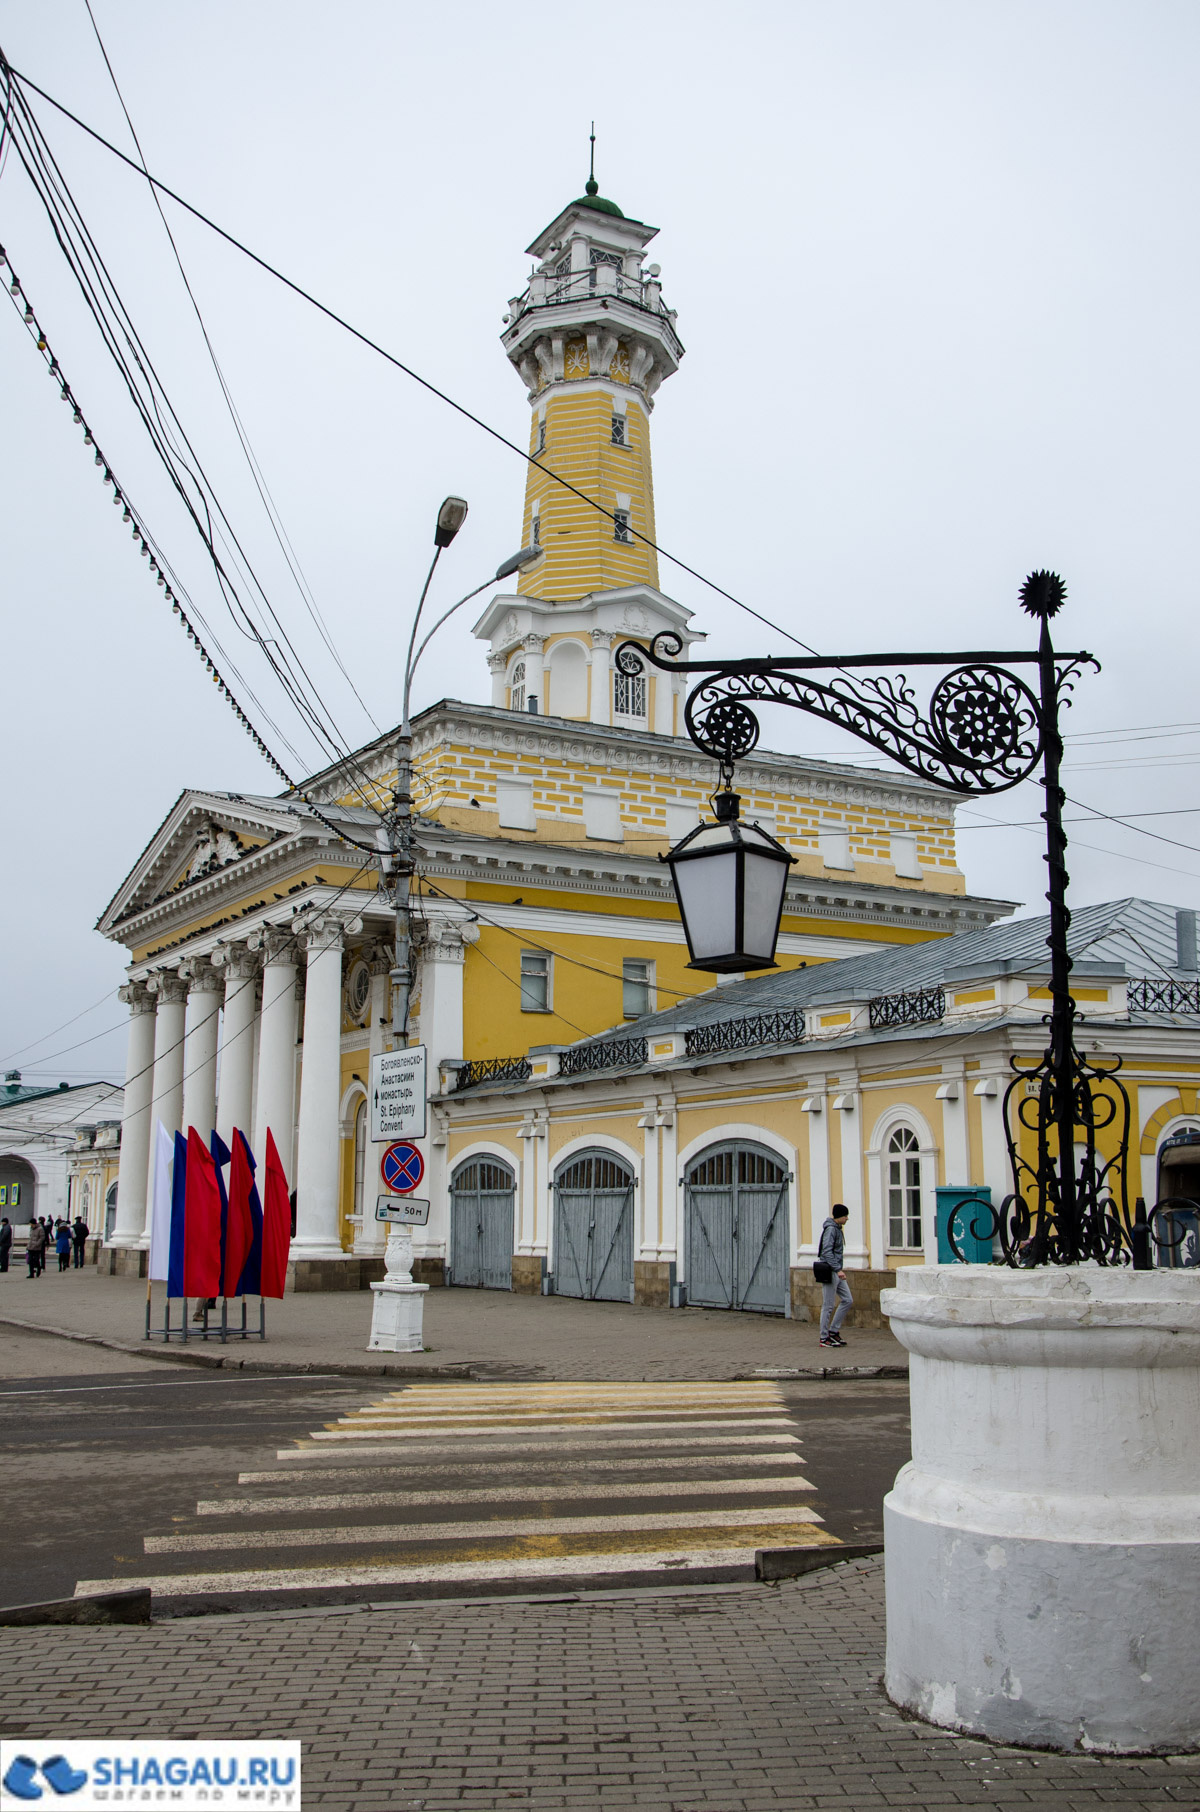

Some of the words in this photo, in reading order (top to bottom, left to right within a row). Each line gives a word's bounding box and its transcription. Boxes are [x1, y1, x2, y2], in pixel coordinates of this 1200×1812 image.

[381, 1055, 422, 1071] Богоявленско-
[381, 1072, 415, 1086] Анастасиин
[380, 1088, 413, 1101] монастырь
[389, 1103, 415, 1118] Epiphany
[380, 1119, 403, 1132] Convent
